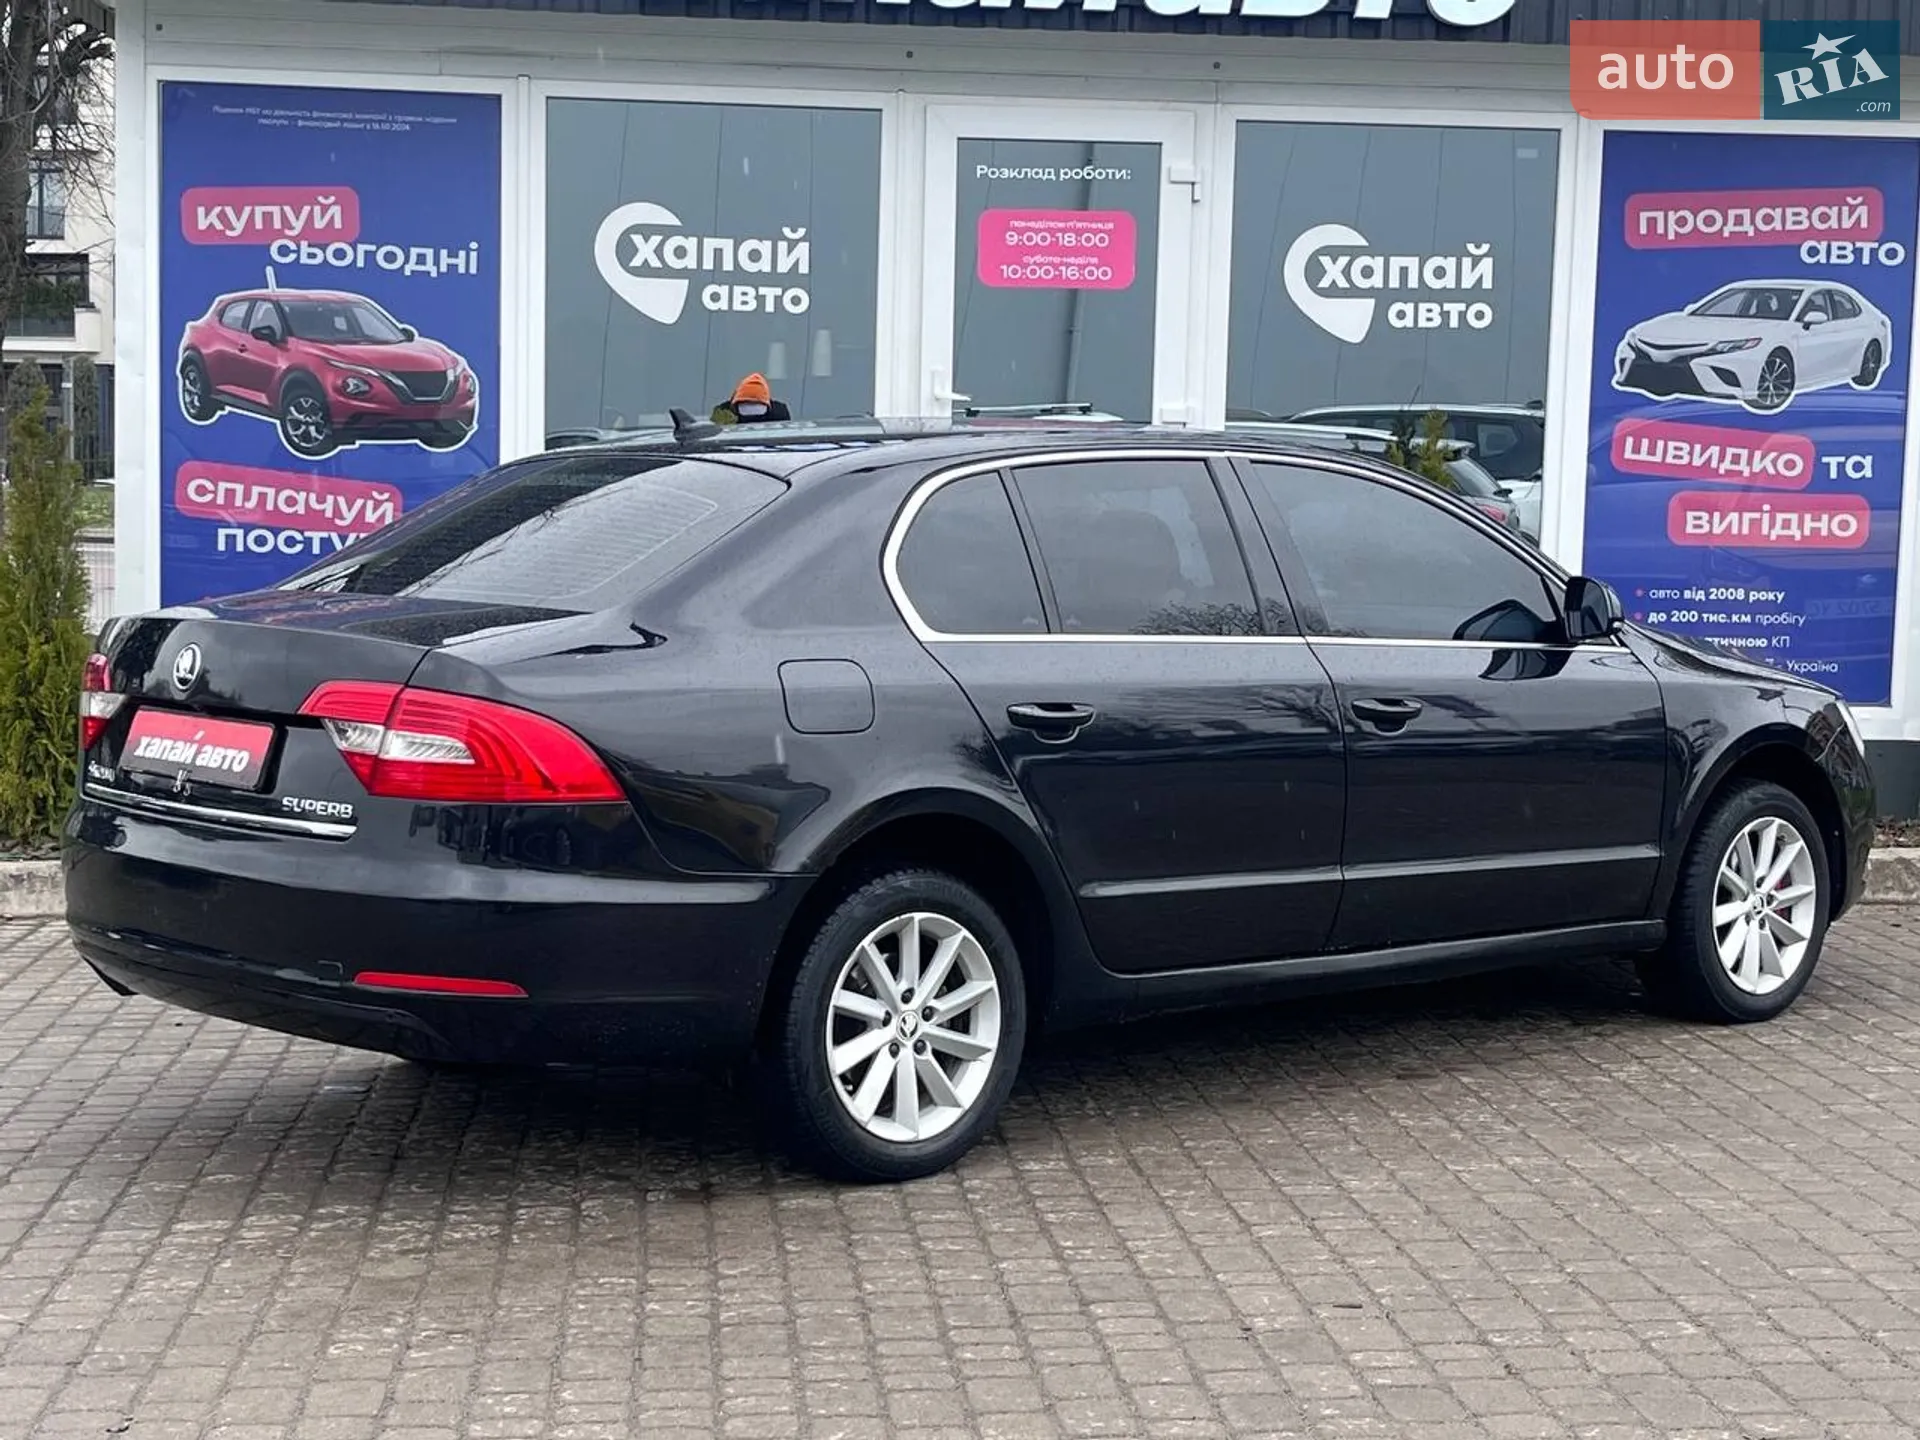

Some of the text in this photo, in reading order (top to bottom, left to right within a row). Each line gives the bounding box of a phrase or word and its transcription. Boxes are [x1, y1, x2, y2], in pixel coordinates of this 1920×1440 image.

[976, 164, 1132, 181] Розклад роботи:
[196, 195, 343, 238] купуй
[1638, 196, 1869, 240] продавай
[629, 226, 810, 275] хапай
[1005, 231, 1109, 247] 9:00-18:00
[1800, 239, 1906, 266] авто
[269, 238, 479, 278] сьогодні
[1316, 242, 1494, 289] хапай
[1000, 264, 1112, 281] 10:00-16:00
[701, 283, 810, 314] авто
[1387, 301, 1493, 329] авто
[1622, 436, 1873, 480] швидко та
[186, 478, 395, 526] сплачуй
[1685, 503, 1858, 541] вигідно
[217, 528, 371, 555] посту
[1649, 587, 1785, 604] авто від 2008 року
[1647, 612, 1667, 624] до
[1670, 610, 1699, 622] 200
[1755, 612, 1806, 627] пробігу
[1771, 636, 1790, 648] КП
[1786, 659, 1839, 674] Україна
[195, 744, 250, 773] авто
[282, 796, 354, 819] SUPERB
